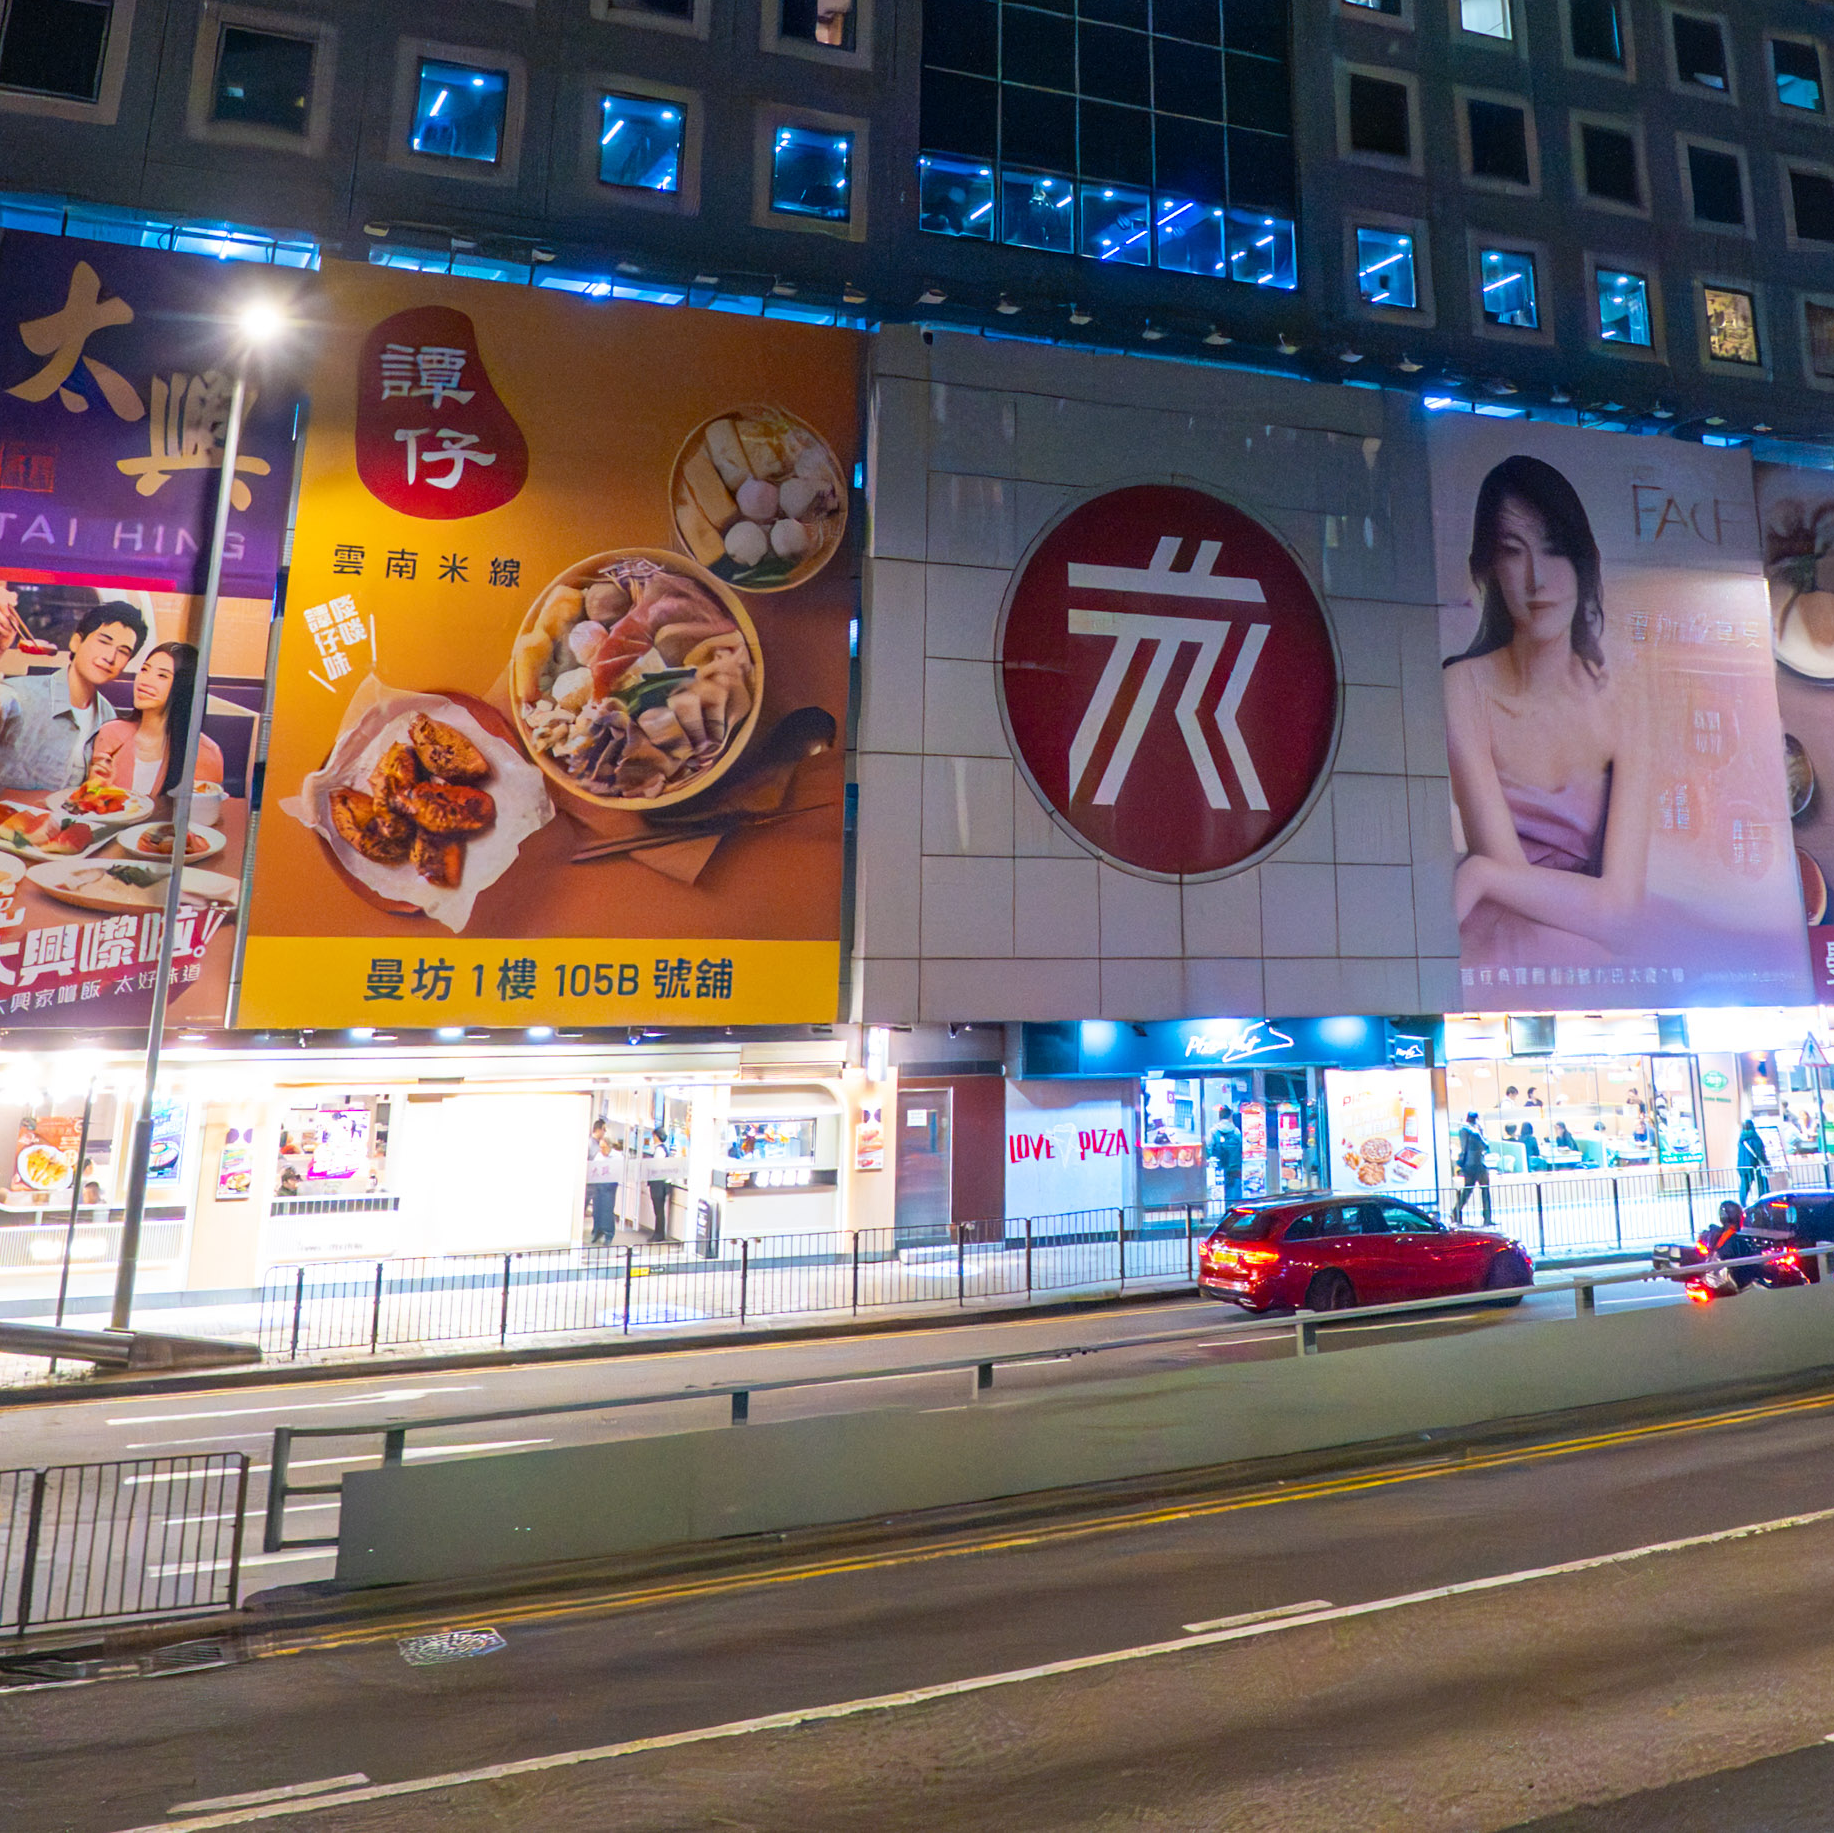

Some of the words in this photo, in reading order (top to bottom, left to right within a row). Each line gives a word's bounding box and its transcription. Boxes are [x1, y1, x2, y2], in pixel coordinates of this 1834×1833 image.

[6, 260, 271, 511] 太興
[380, 343, 497, 490] 譚仔
[333, 543, 521, 587] 雲南米線
[362, 958, 456, 1002] 曼坊
[471, 963, 485, 997] 1
[496, 957, 538, 1002] 樓
[554, 963, 641, 997] 105B
[652, 957, 735, 1000] 號舖
[1009, 1133, 1056, 1164] LOVE
[1078, 1128, 1130, 1161] PIZZA
